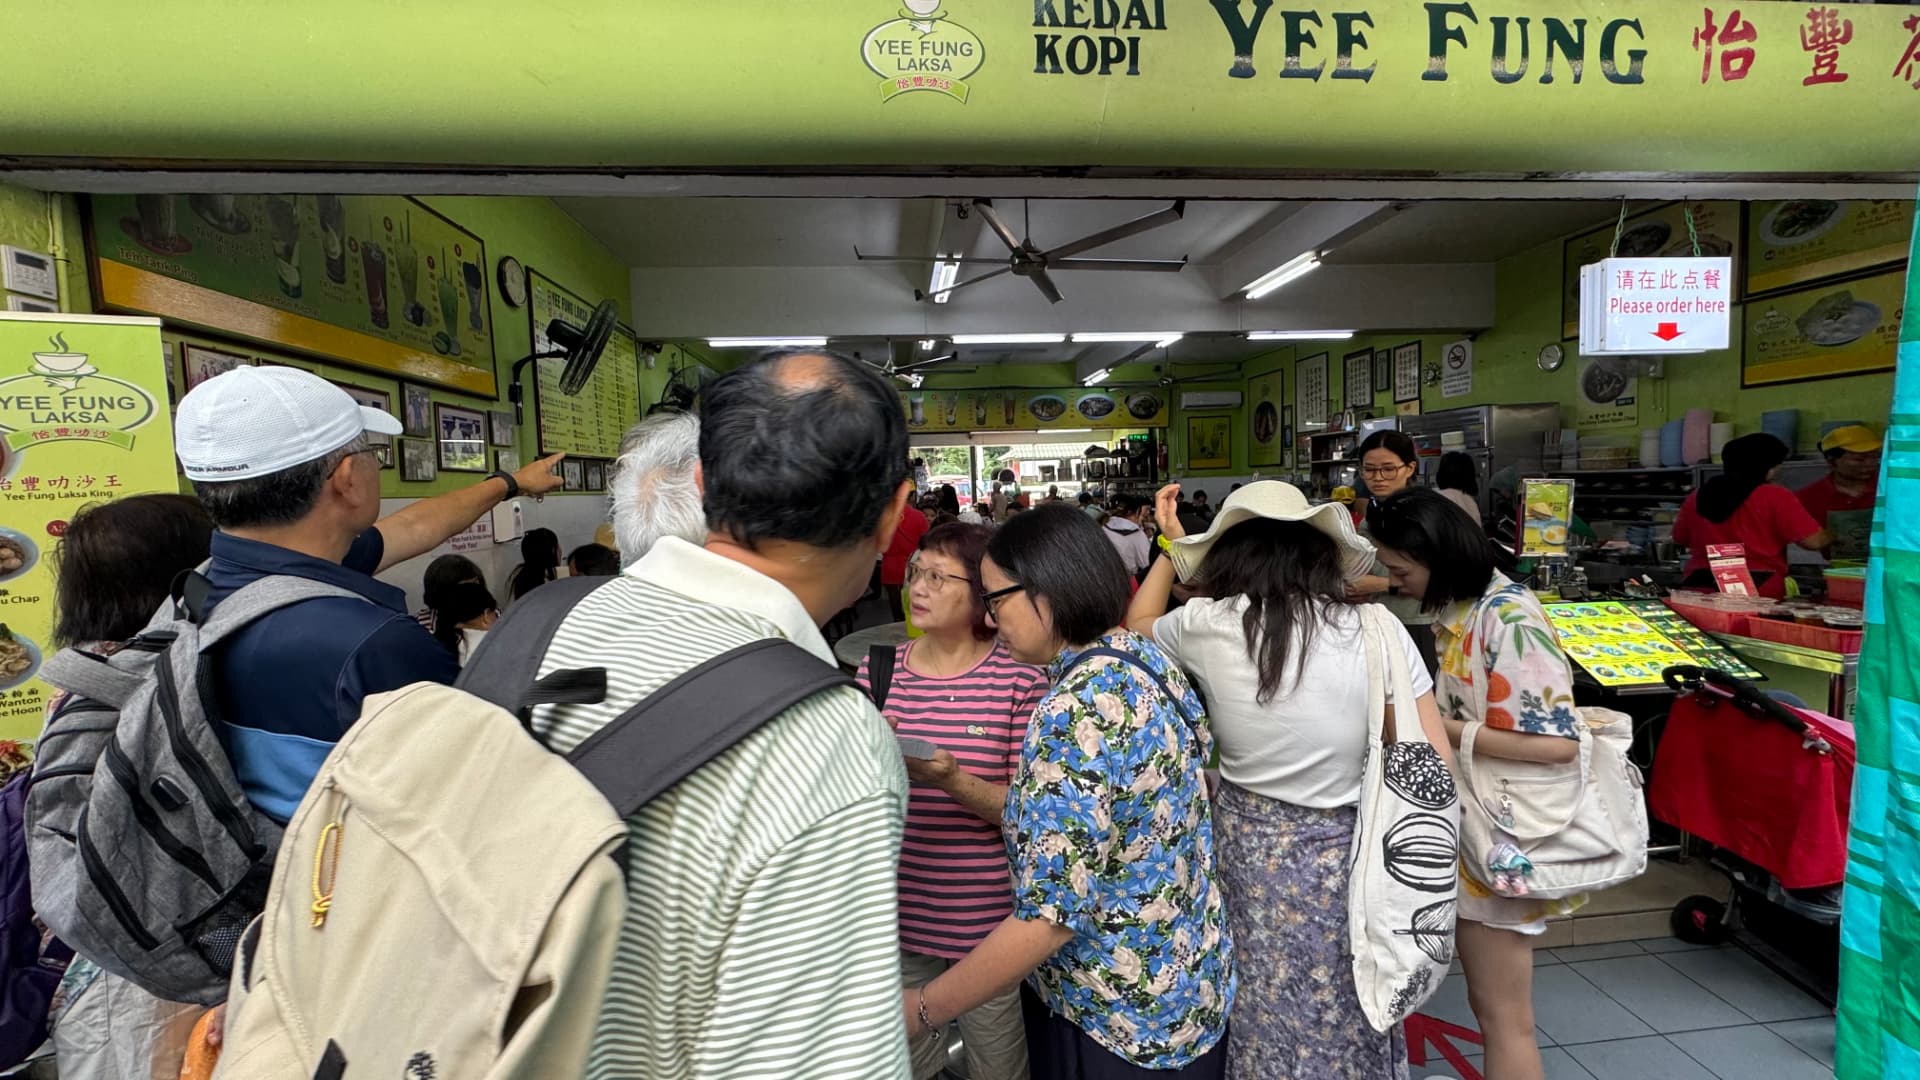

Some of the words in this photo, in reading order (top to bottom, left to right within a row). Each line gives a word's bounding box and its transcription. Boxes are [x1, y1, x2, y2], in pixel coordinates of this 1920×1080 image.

[1032, 0, 1167, 30] KEDAI
[875, 40, 913, 56] YEE
[920, 41, 973, 57] FUNG
[1209, 0, 1377, 83] YEE
[1421, 2, 1648, 85] FUNG
[1033, 34, 1141, 76] KOPI
[897, 58, 952, 72] LAKSA
[1616, 269, 1721, 291] 请在此点餐
[1610, 297, 1653, 314] Please
[1656, 297, 1693, 313] order
[1695, 297, 1725, 313] here
[0, 396, 51, 410] YEE
[63, 396, 135, 410] FUNG
[31, 412, 109, 424] LAKSA
[4, 493, 25, 501] Yee
[28, 492, 55, 501] Fung
[58, 490, 87, 500] Laksa
[90, 489, 113, 499] King
[11, 596, 40, 604] Chap
